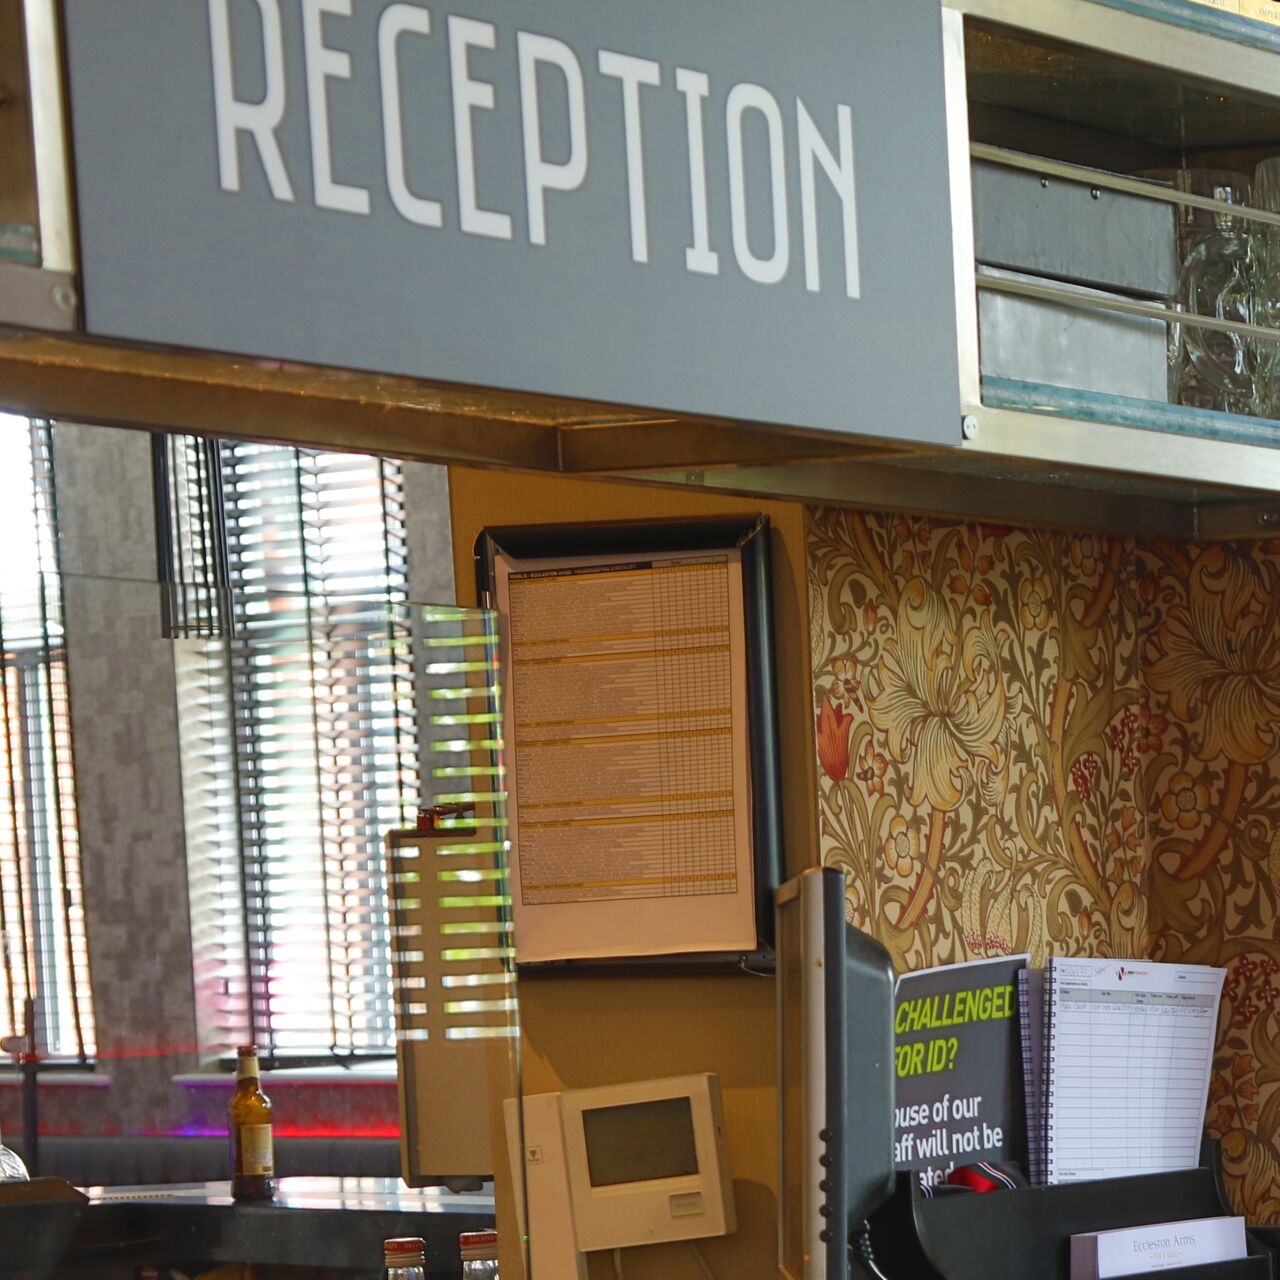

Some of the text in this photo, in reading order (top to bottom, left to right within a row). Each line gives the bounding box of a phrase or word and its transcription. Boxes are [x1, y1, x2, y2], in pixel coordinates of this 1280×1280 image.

[208, 0, 861, 299] RECEPTION
[926, 1036, 959, 1073] ID?
[932, 1094, 950, 1123] of
[952, 1096, 983, 1120] our
[916, 1128, 949, 1158] will
[952, 1124, 981, 1154] not
[982, 1122, 1004, 1149] be
[1133, 1234, 1196, 1252] Eccleston Arms
